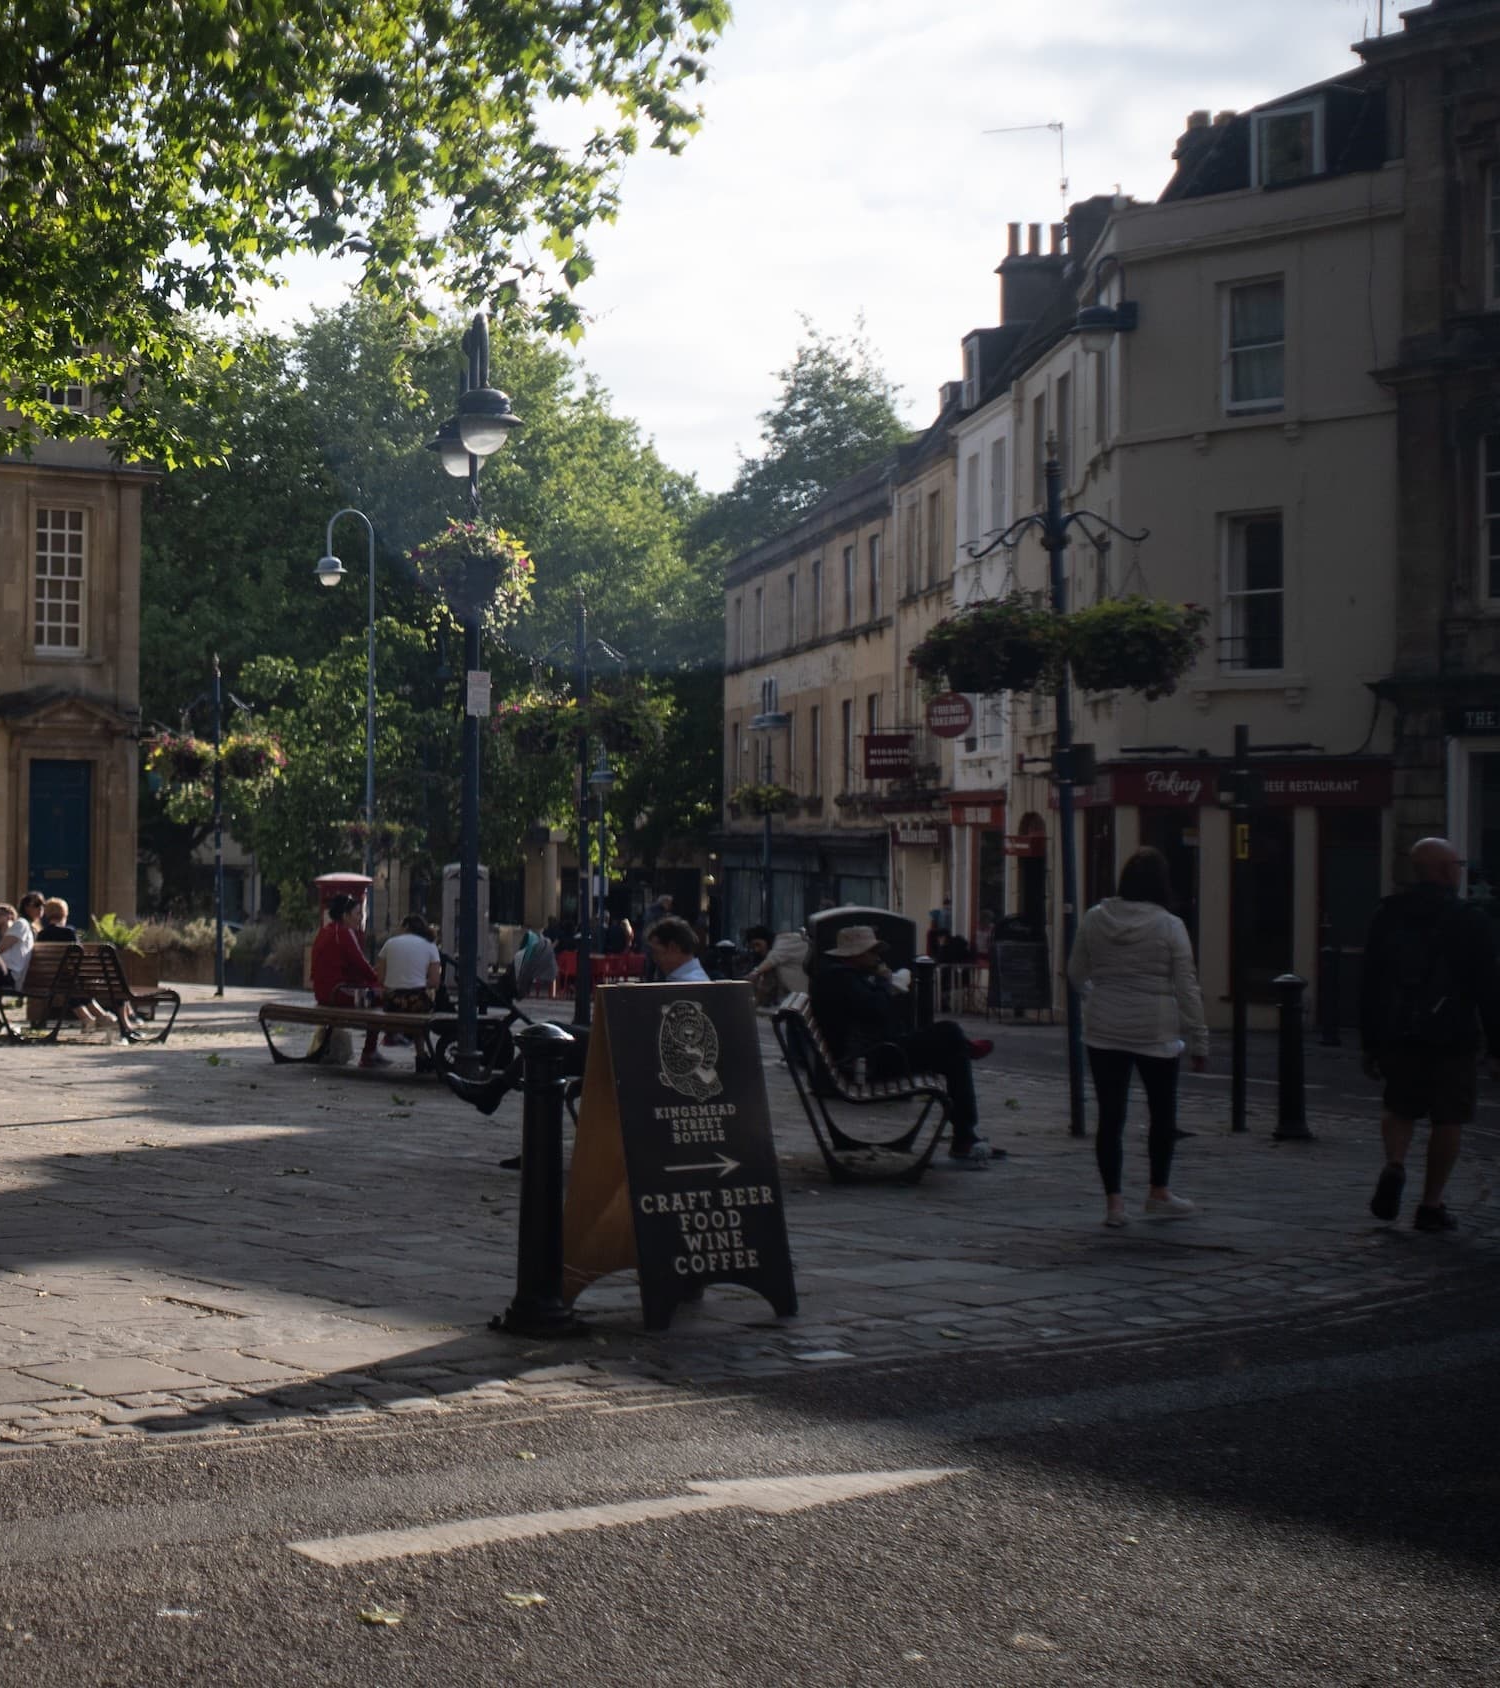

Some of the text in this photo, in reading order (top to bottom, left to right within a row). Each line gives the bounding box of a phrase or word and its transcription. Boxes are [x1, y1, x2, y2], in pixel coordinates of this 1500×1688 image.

[1465, 711, 1496, 726] THE
[869, 747, 910, 756] MISSION
[869, 757, 910, 766] BURRITO
[1145, 770, 1202, 803] Peking
[1288, 778, 1360, 793] RESTAURANT
[654, 1103, 737, 1120] KINGSMEAD
[672, 1116, 723, 1132] STREET
[673, 1129, 726, 1145] BOTTLE
[640, 1185, 775, 1215] CRAFT BEER
[678, 1209, 742, 1233] FOOD
[682, 1229, 745, 1253] WINE
[674, 1249, 760, 1276] COFFEE
